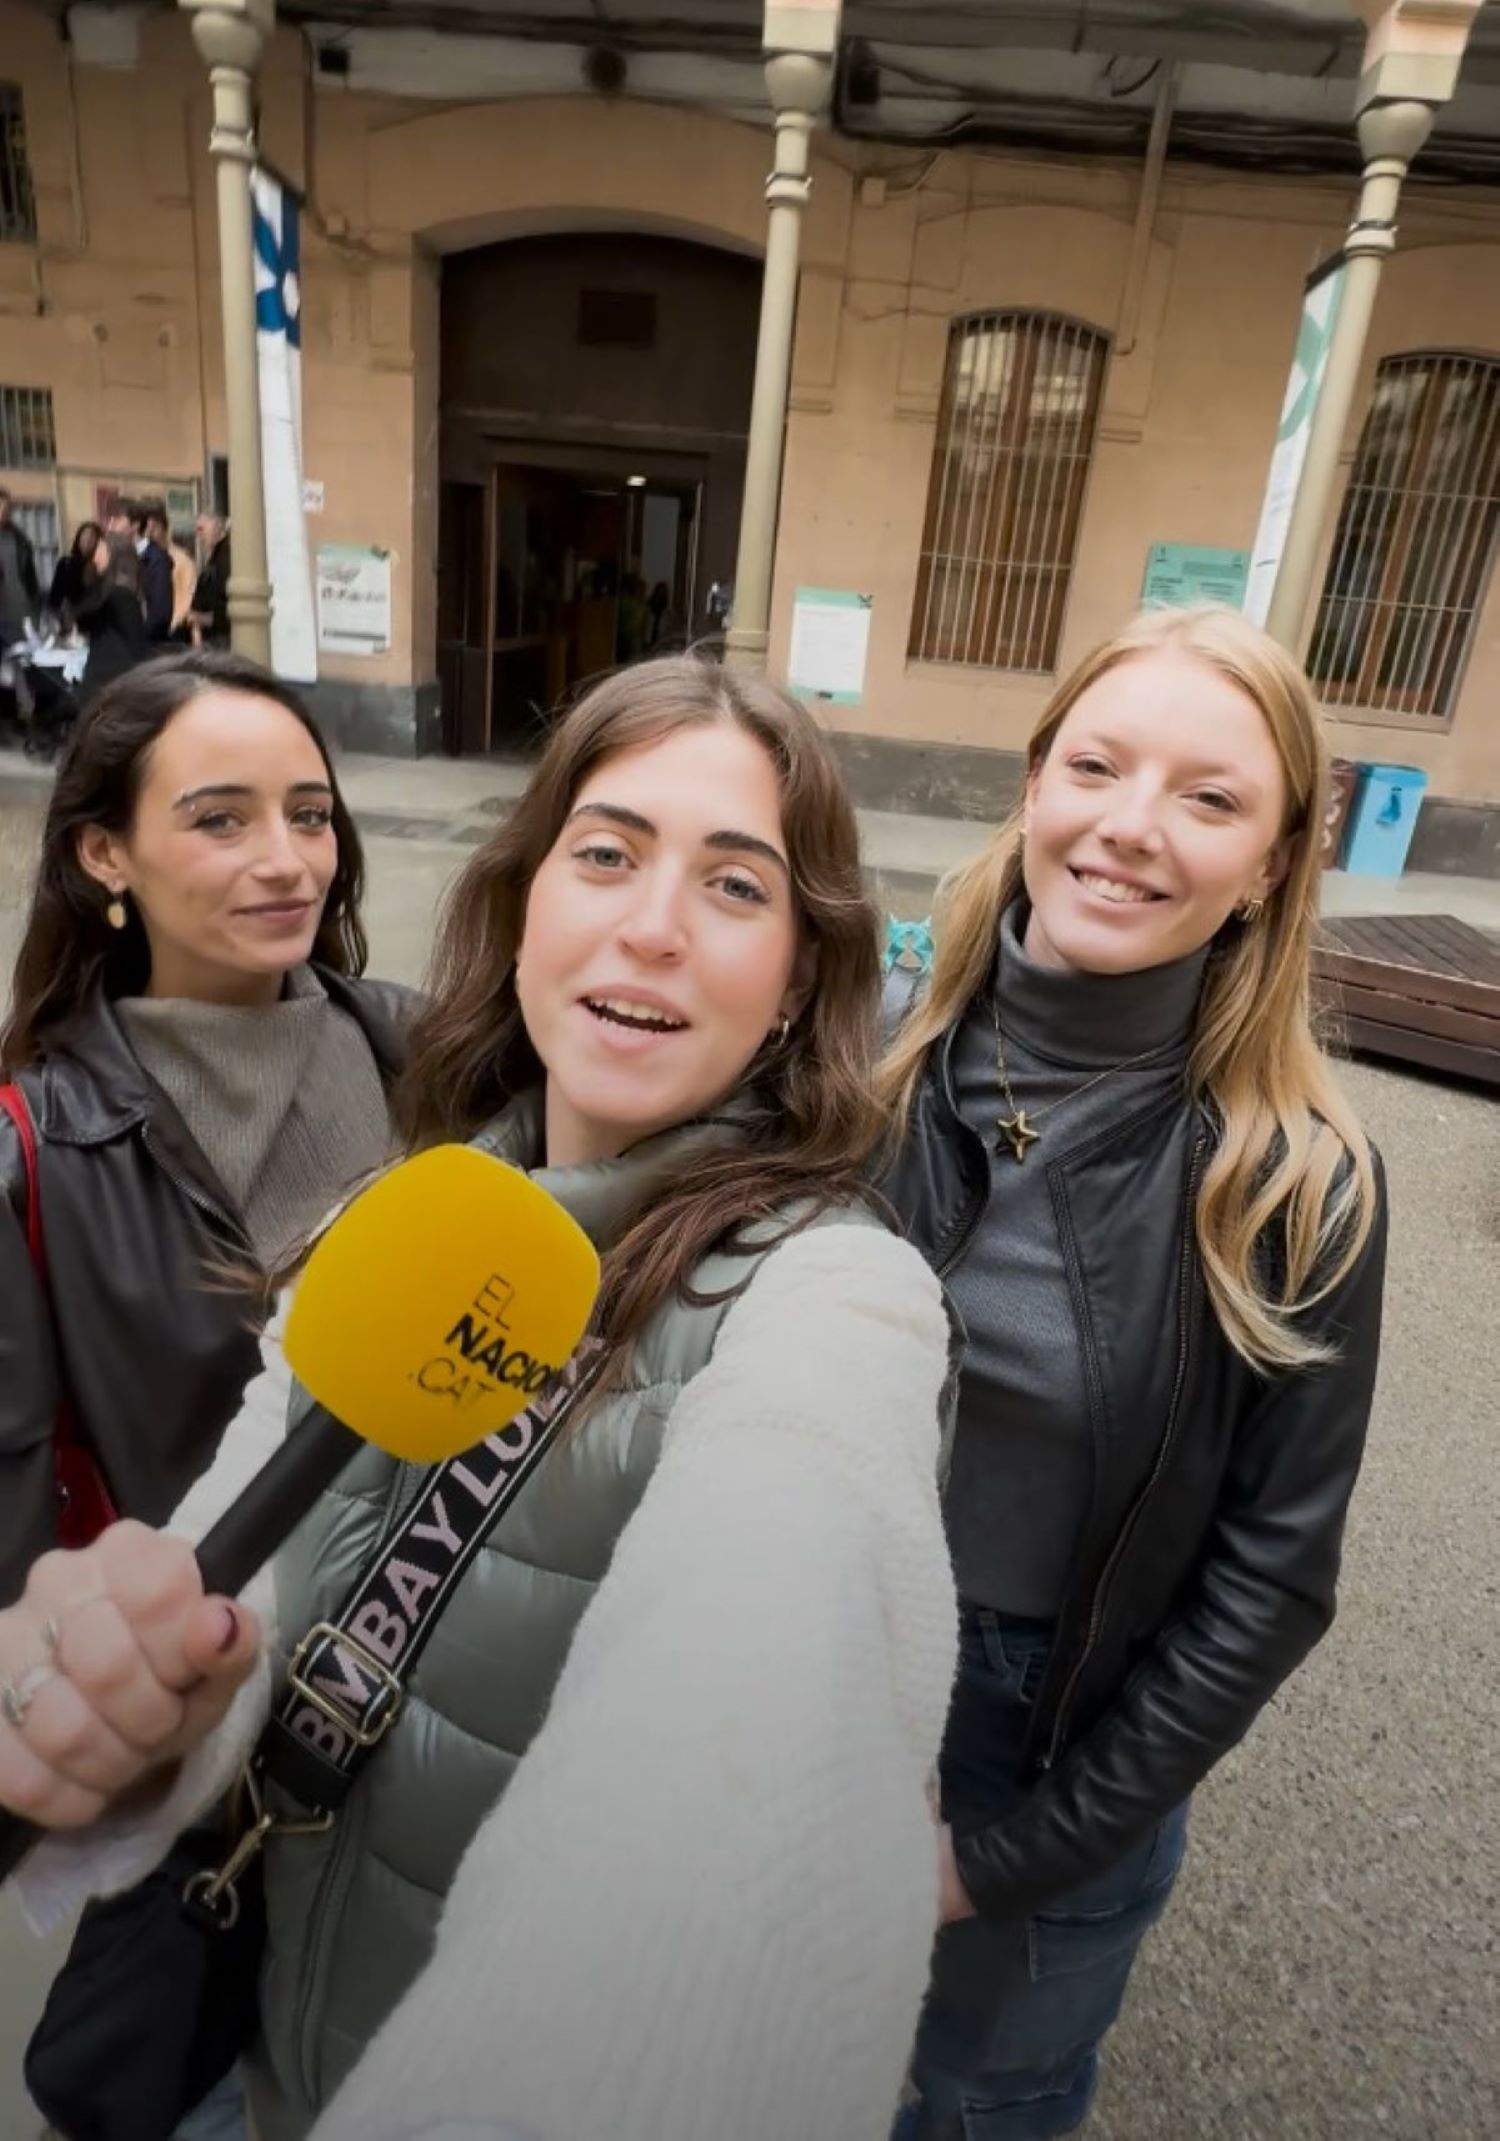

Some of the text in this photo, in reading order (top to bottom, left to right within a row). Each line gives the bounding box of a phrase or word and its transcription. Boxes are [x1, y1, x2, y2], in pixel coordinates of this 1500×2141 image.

[472, 1272, 516, 1332] EL
[443, 1313, 558, 1394] NACIO
[290, 1557, 443, 1765] BMBA
[409, 1490, 464, 1554] Y
